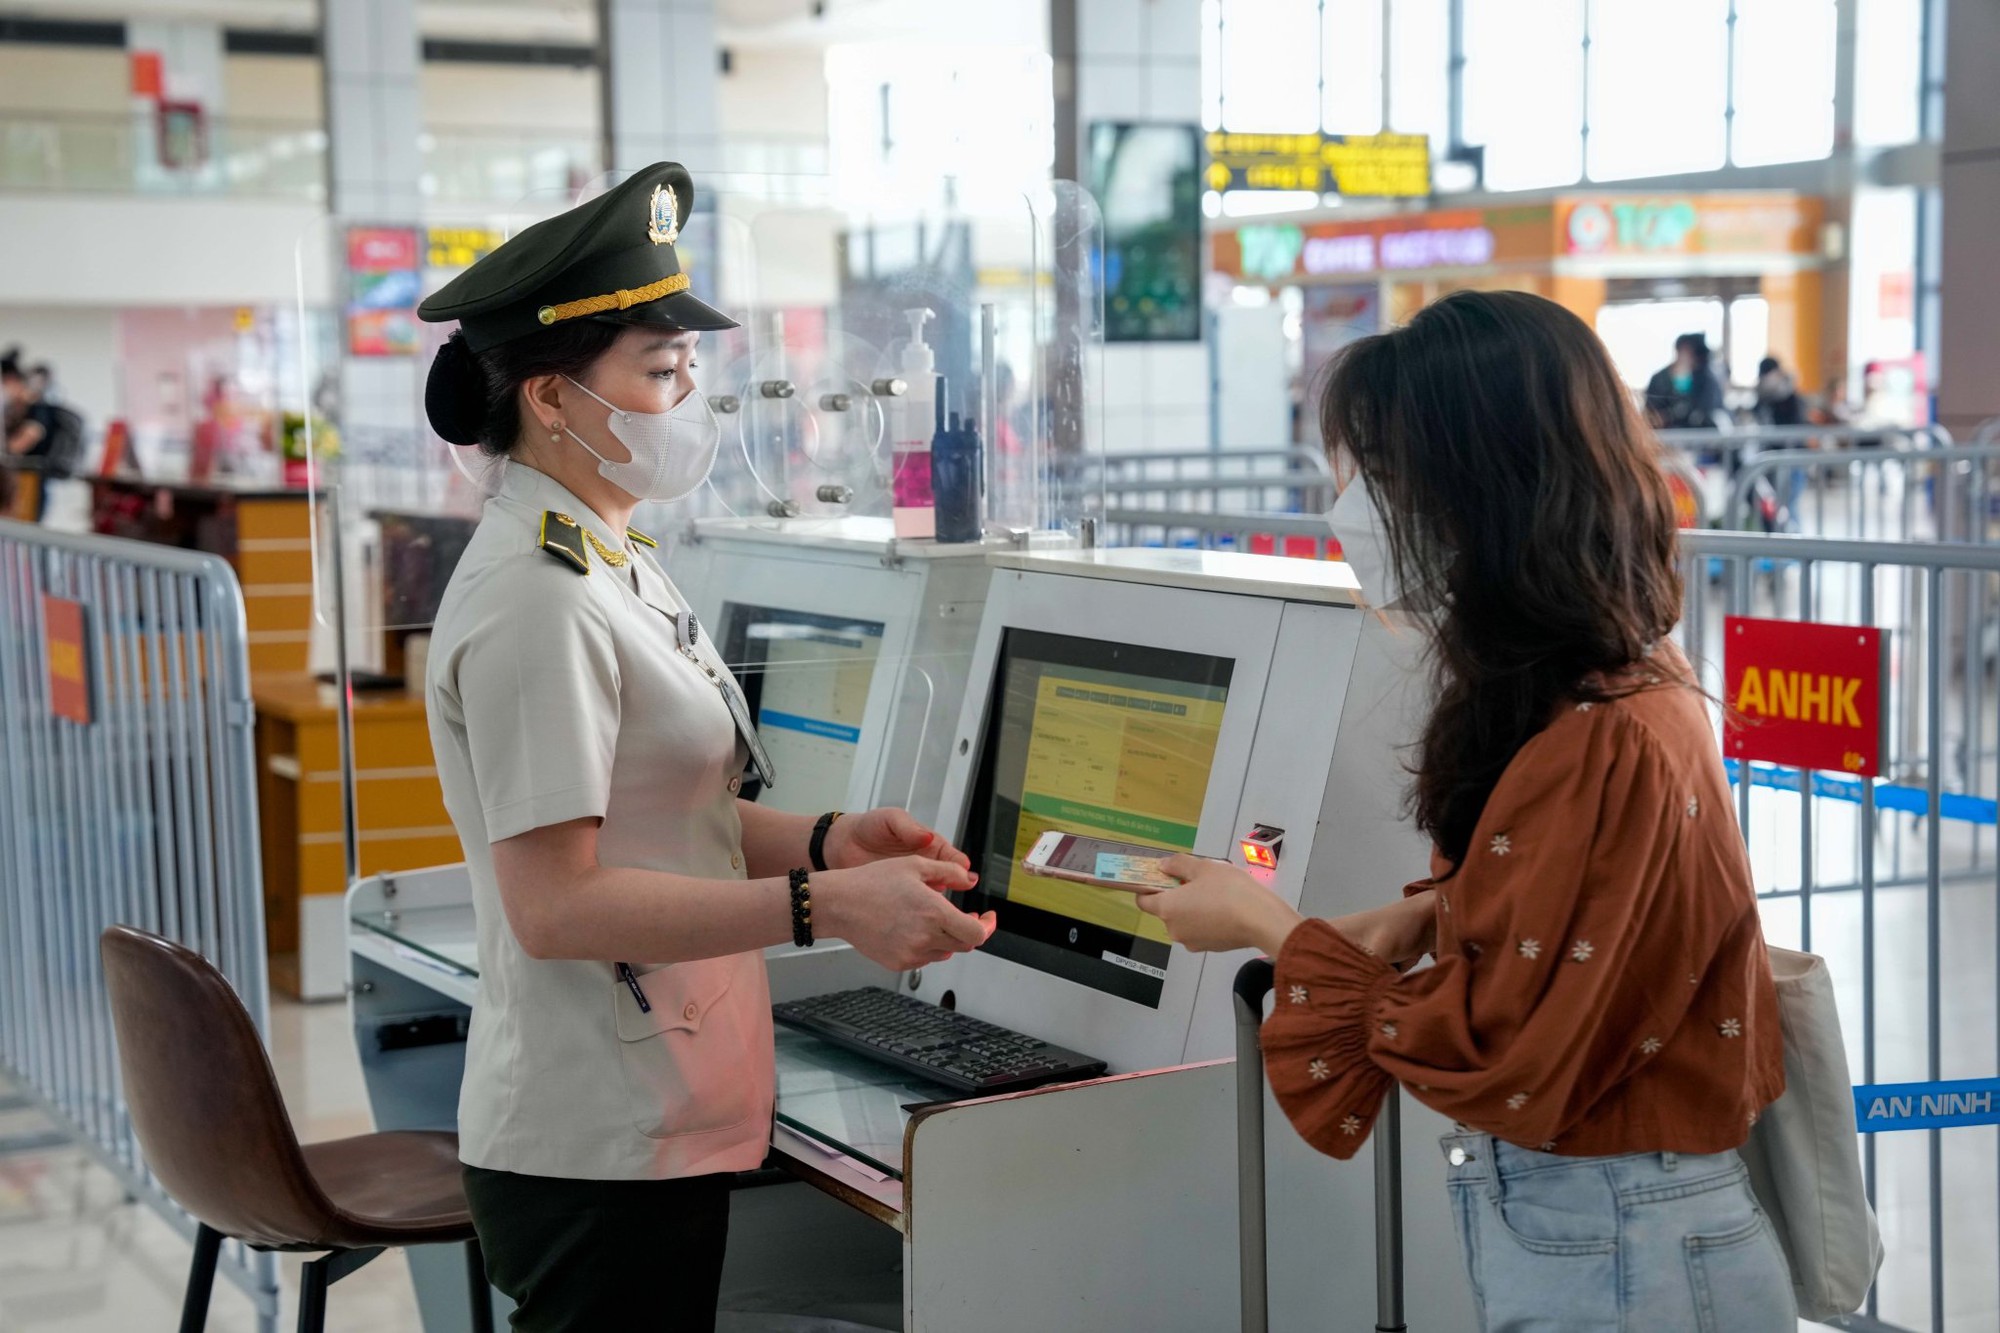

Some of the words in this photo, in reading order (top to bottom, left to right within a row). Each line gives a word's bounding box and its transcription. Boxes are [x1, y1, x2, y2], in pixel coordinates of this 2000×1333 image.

[1737, 667, 1862, 728] ANHK
[1867, 1097, 1912, 1119] AN
[1921, 1091, 1991, 1116] NINH
